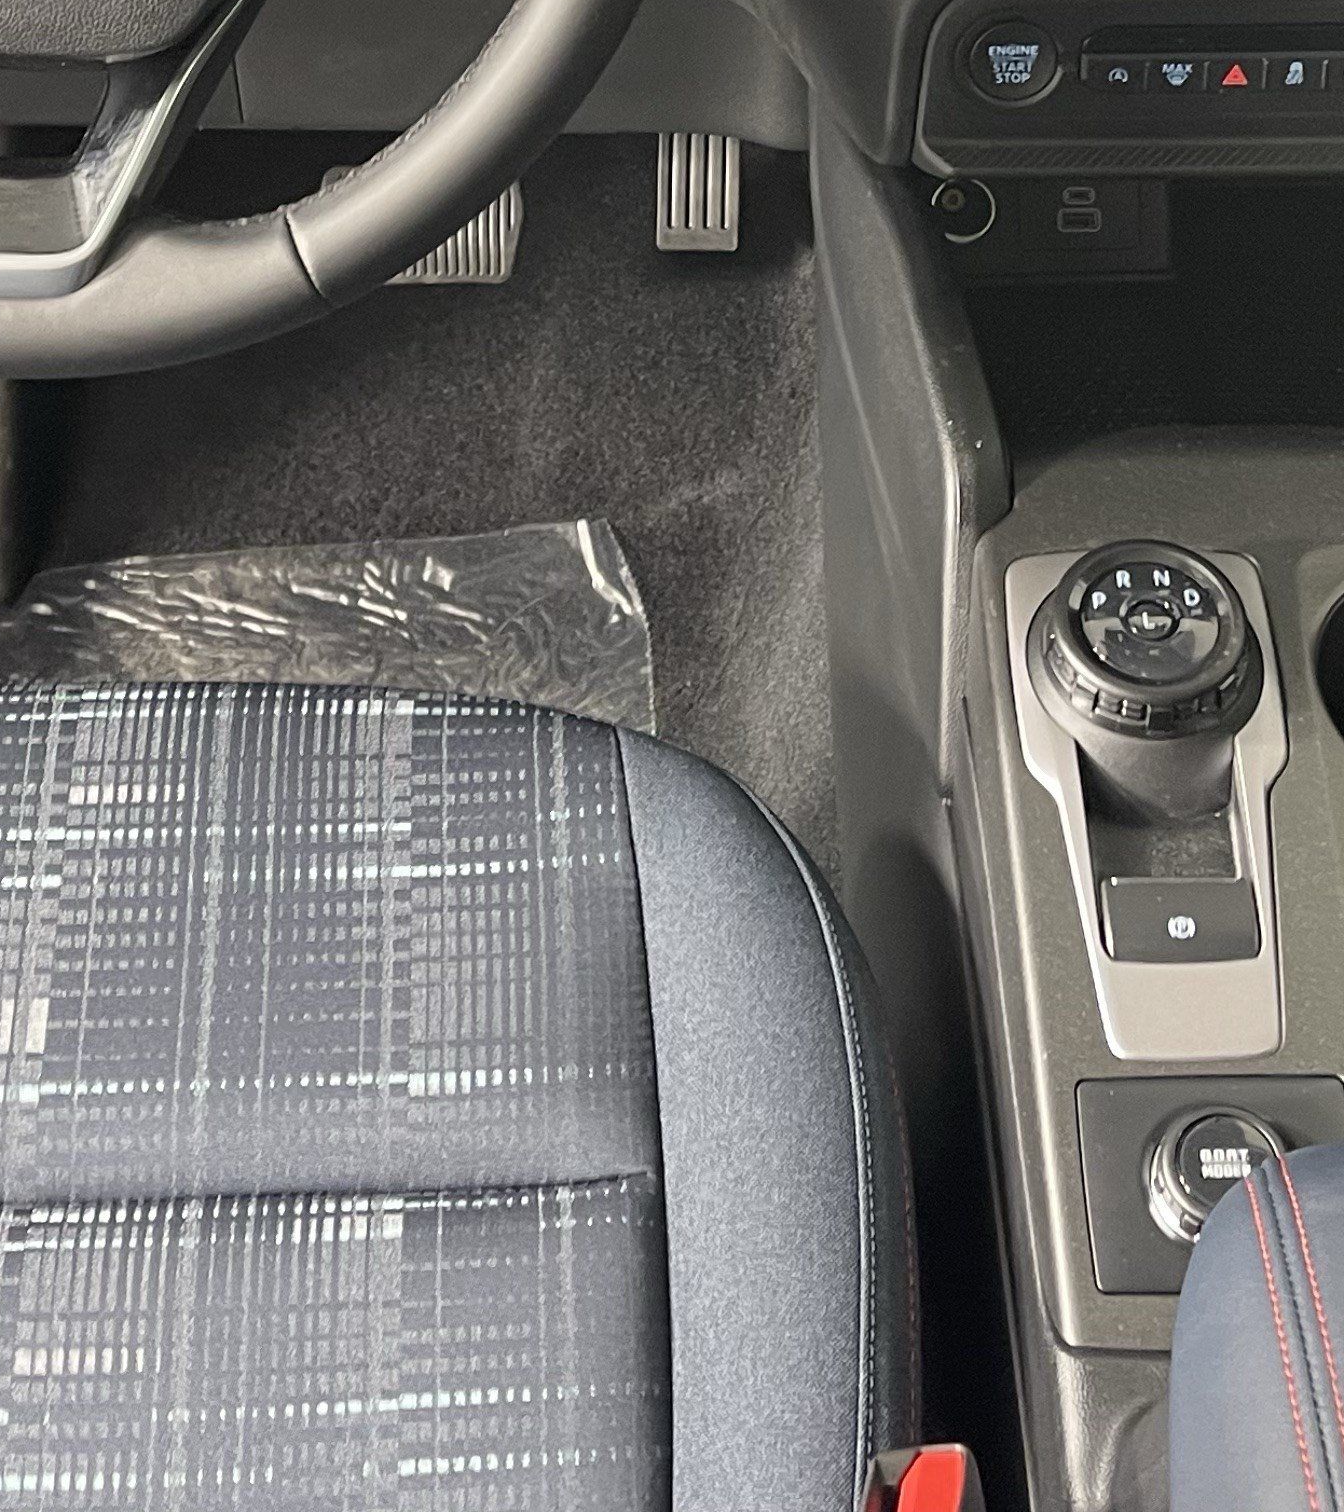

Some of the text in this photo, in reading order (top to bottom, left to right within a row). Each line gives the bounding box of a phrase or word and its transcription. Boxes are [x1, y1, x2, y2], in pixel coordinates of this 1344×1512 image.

[987, 44, 1039, 57] ENGINE
[992, 60, 1033, 73] START
[1161, 63, 1193, 74] MAX
[995, 72, 1031, 84] STOP
[1115, 569, 1131, 588] R
[1152, 569, 1170, 587] N
[1091, 591, 1106, 609] P
[1183, 588, 1201, 607] D
[1141, 611, 1155, 630] L
